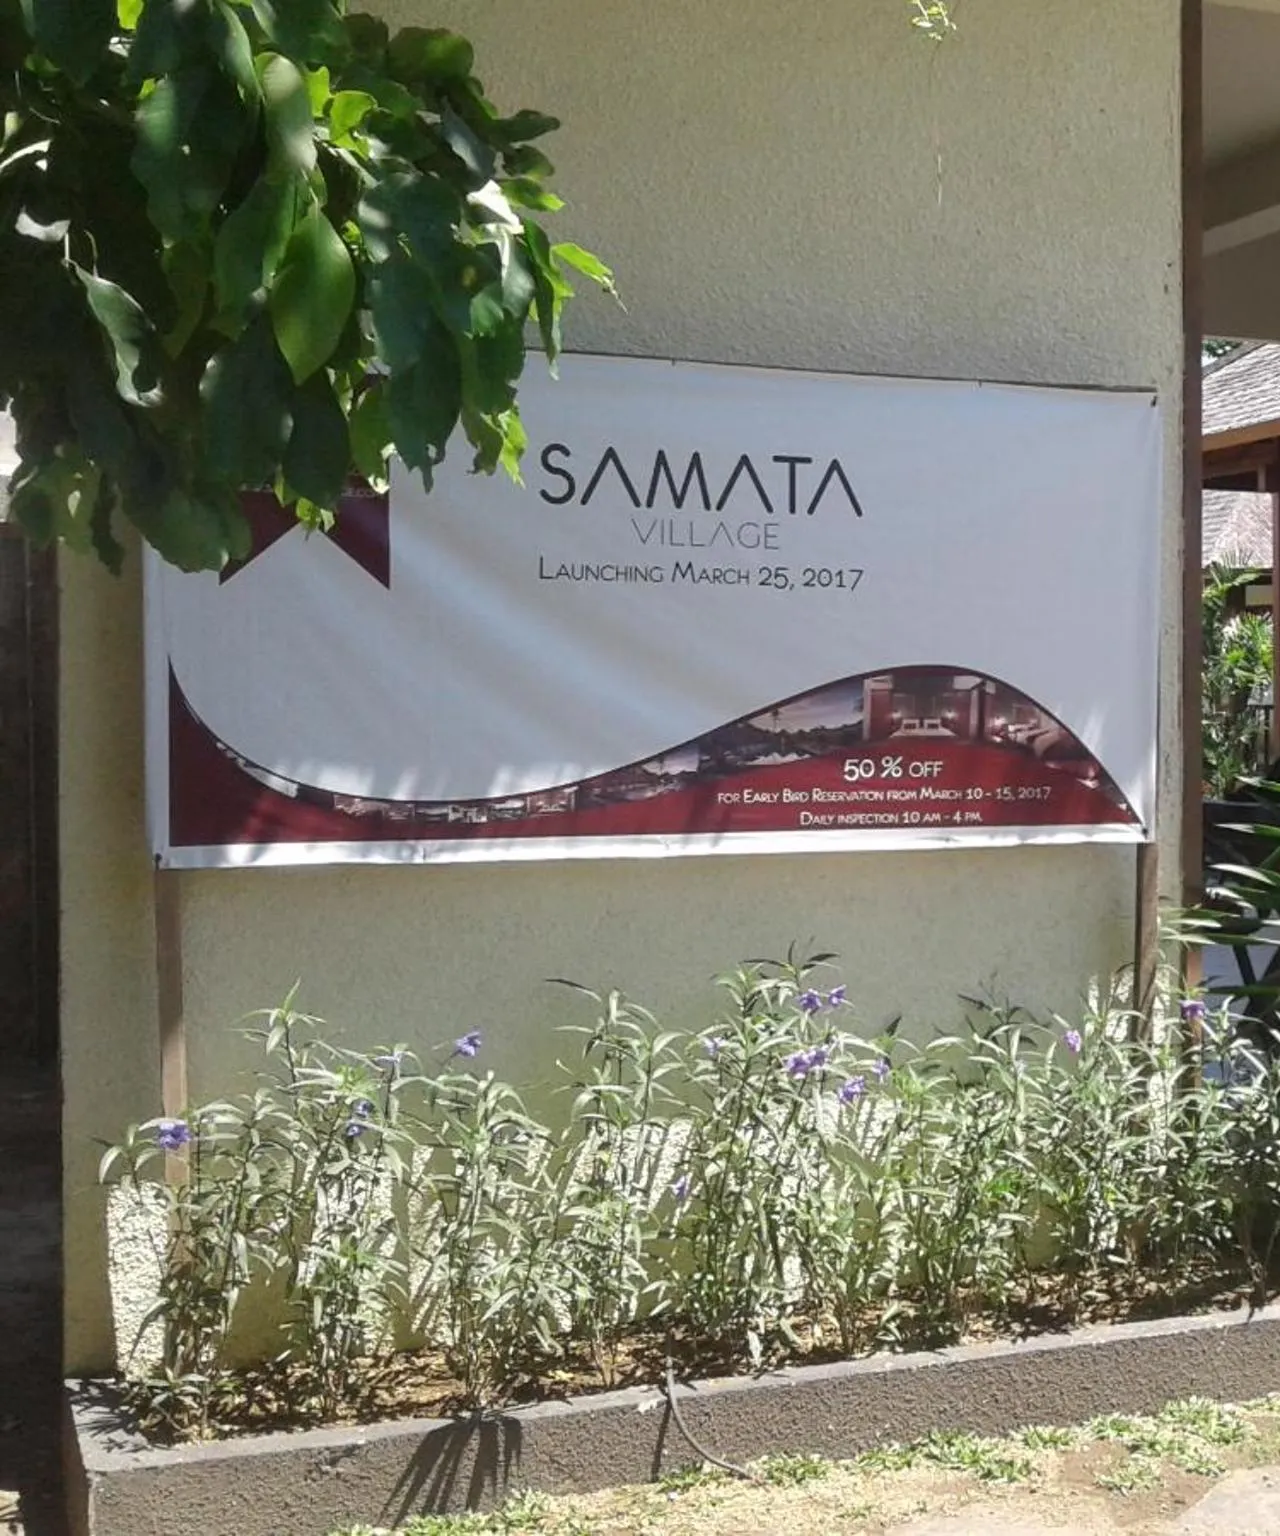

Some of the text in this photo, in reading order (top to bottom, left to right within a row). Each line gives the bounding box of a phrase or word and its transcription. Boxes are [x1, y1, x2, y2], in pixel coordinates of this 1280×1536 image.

[539, 443, 863, 517] SAMATA
[631, 518, 779, 550] VILLAGE
[538, 556, 864, 591] LAUNCHING MARCH 25, 2017
[843, 756, 944, 781] 50 % OFF
[718, 792, 741, 804] FOR
[743, 788, 780, 803] EARLY
[782, 788, 808, 803] BIRD
[812, 787, 884, 802] RESERVATION
[886, 789, 917, 800] FROM
[919, 786, 962, 800] MARCH
[966, 787, 983, 800] 10
[996, 787, 1015, 801] 15,
[1018, 786, 1052, 800] 2017
[799, 811, 835, 826] DAILY
[837, 813, 898, 825] INSPECTION
[902, 811, 920, 824] 10
[923, 812, 942, 822] AM
[953, 810, 962, 823] 4
